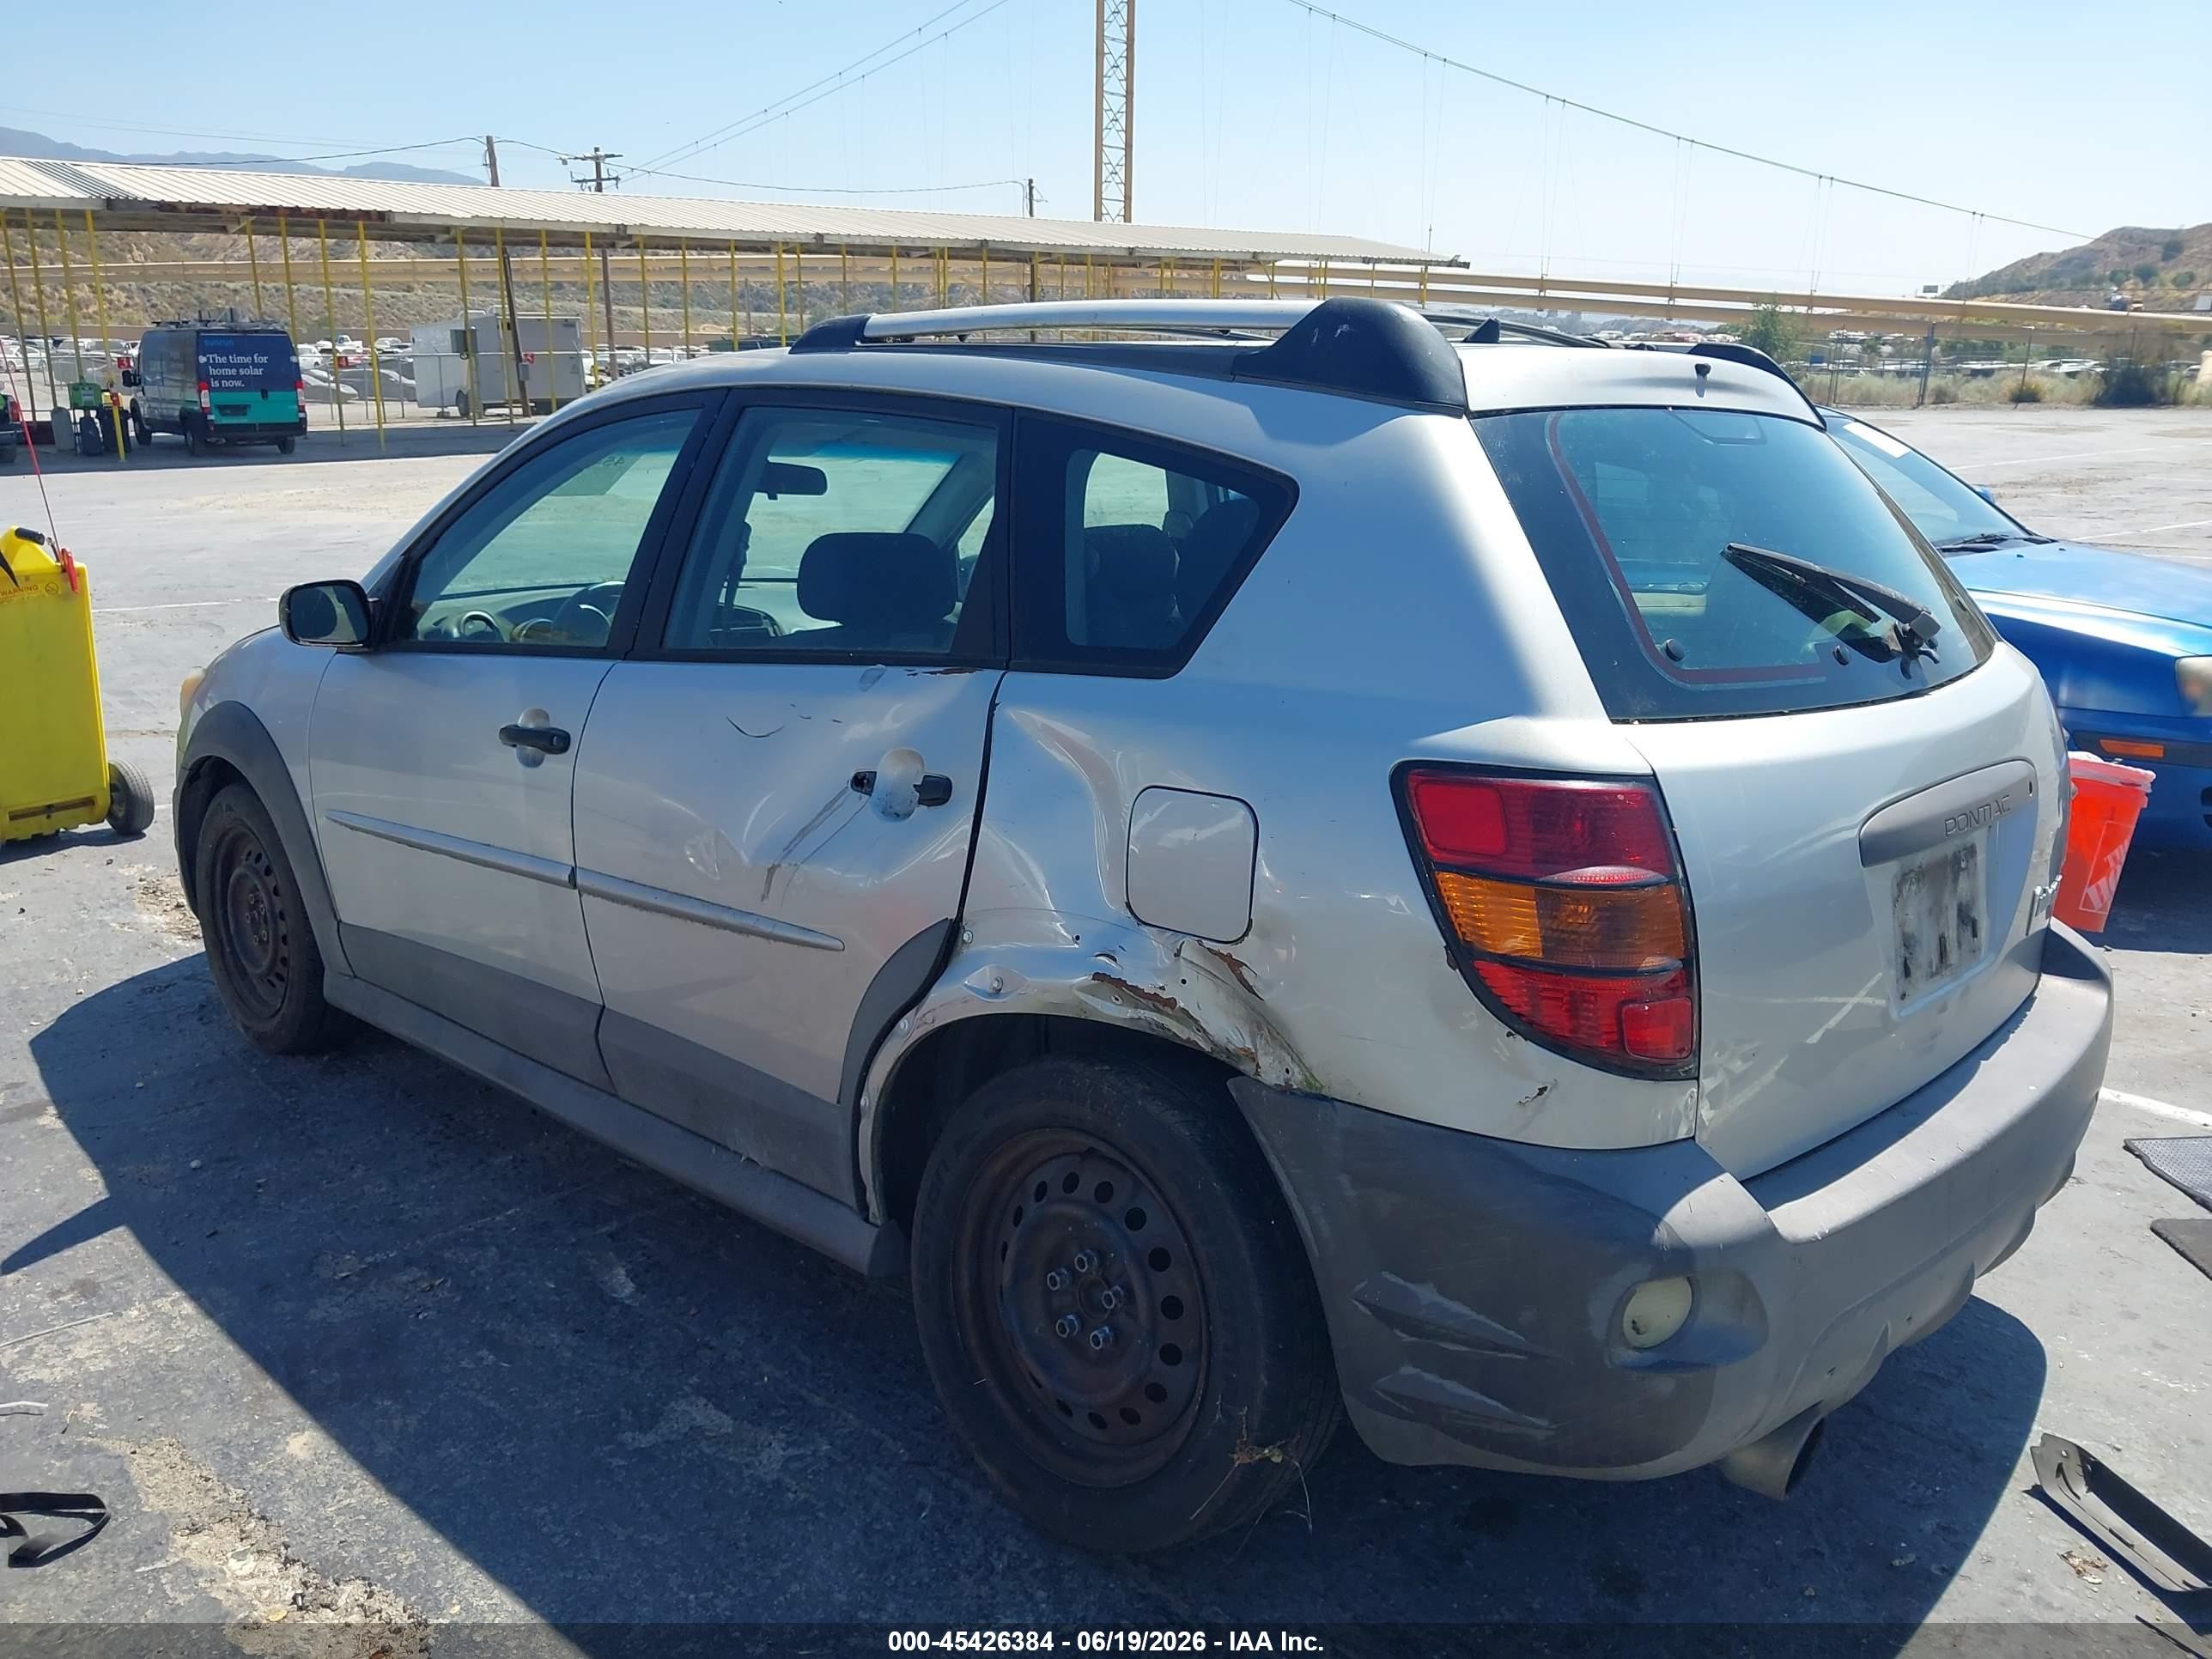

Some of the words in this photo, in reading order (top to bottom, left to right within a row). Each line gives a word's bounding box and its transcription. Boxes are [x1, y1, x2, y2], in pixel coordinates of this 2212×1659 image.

[206, 353, 227, 363] The
[228, 354, 252, 363] time
[253, 353, 269, 363] for
[209, 366, 237, 375] home
[239, 365, 264, 375] solar
[210, 378, 220, 387] is
[1944, 794, 2011, 838] PONTIAC
